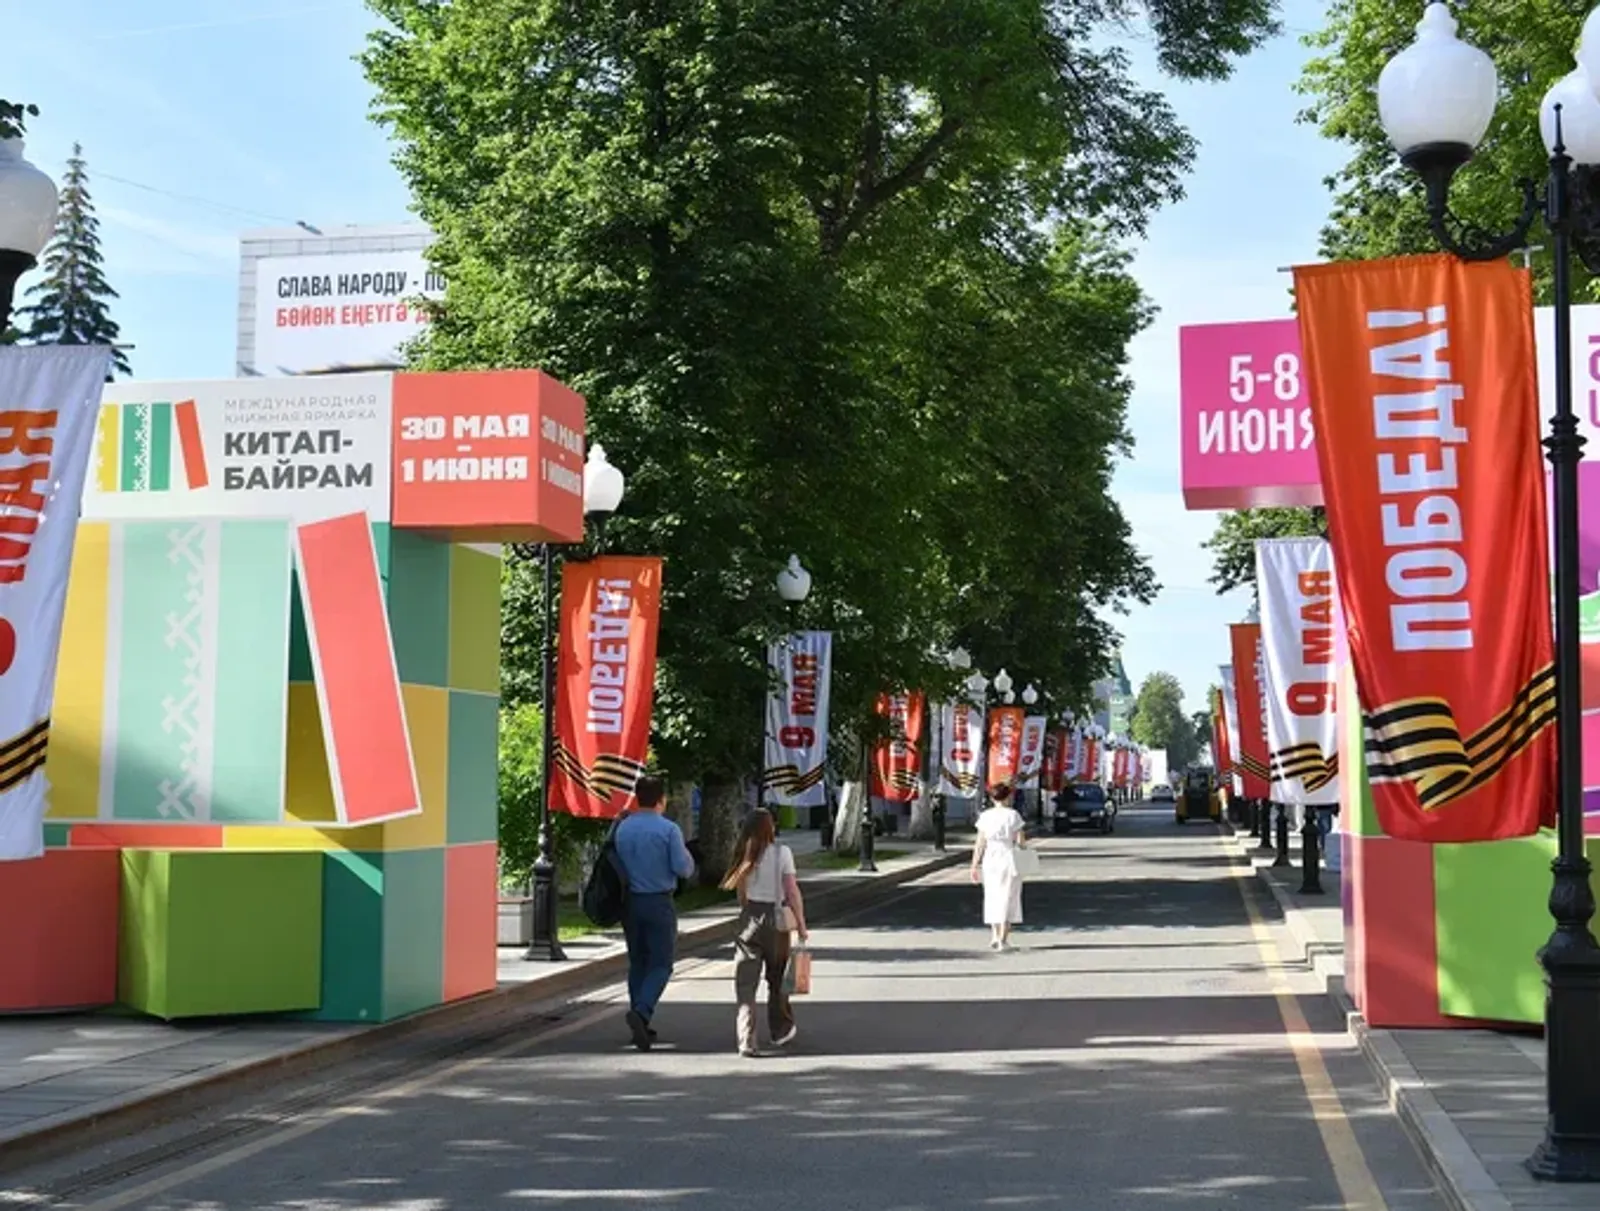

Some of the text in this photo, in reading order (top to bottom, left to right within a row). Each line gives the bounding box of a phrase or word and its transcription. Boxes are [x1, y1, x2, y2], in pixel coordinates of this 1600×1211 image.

[277, 274, 332, 298] СЛАВА
[337, 271, 407, 297] НАРОДУ
[1228, 353, 1300, 403] 5-8
[224, 394, 377, 411] МЕЖДУНАРОДНАЯ
[224, 408, 377, 424] КНИЖНАЯ ЯРМАРКА
[401, 413, 530, 441] 30 МАЯ
[1198, 406, 1316, 455] ИЮНЯ
[224, 429, 353, 457] КИТАП-
[224, 457, 373, 491] БАЙРАМ
[401, 458, 416, 482] 1
[422, 456, 529, 482] ИЮНЯ
[1366, 304, 1475, 652] ПОБЕДА!
[1286, 571, 1337, 716] 9 МАЯ
[779, 653, 818, 749] 9 МАЯ
